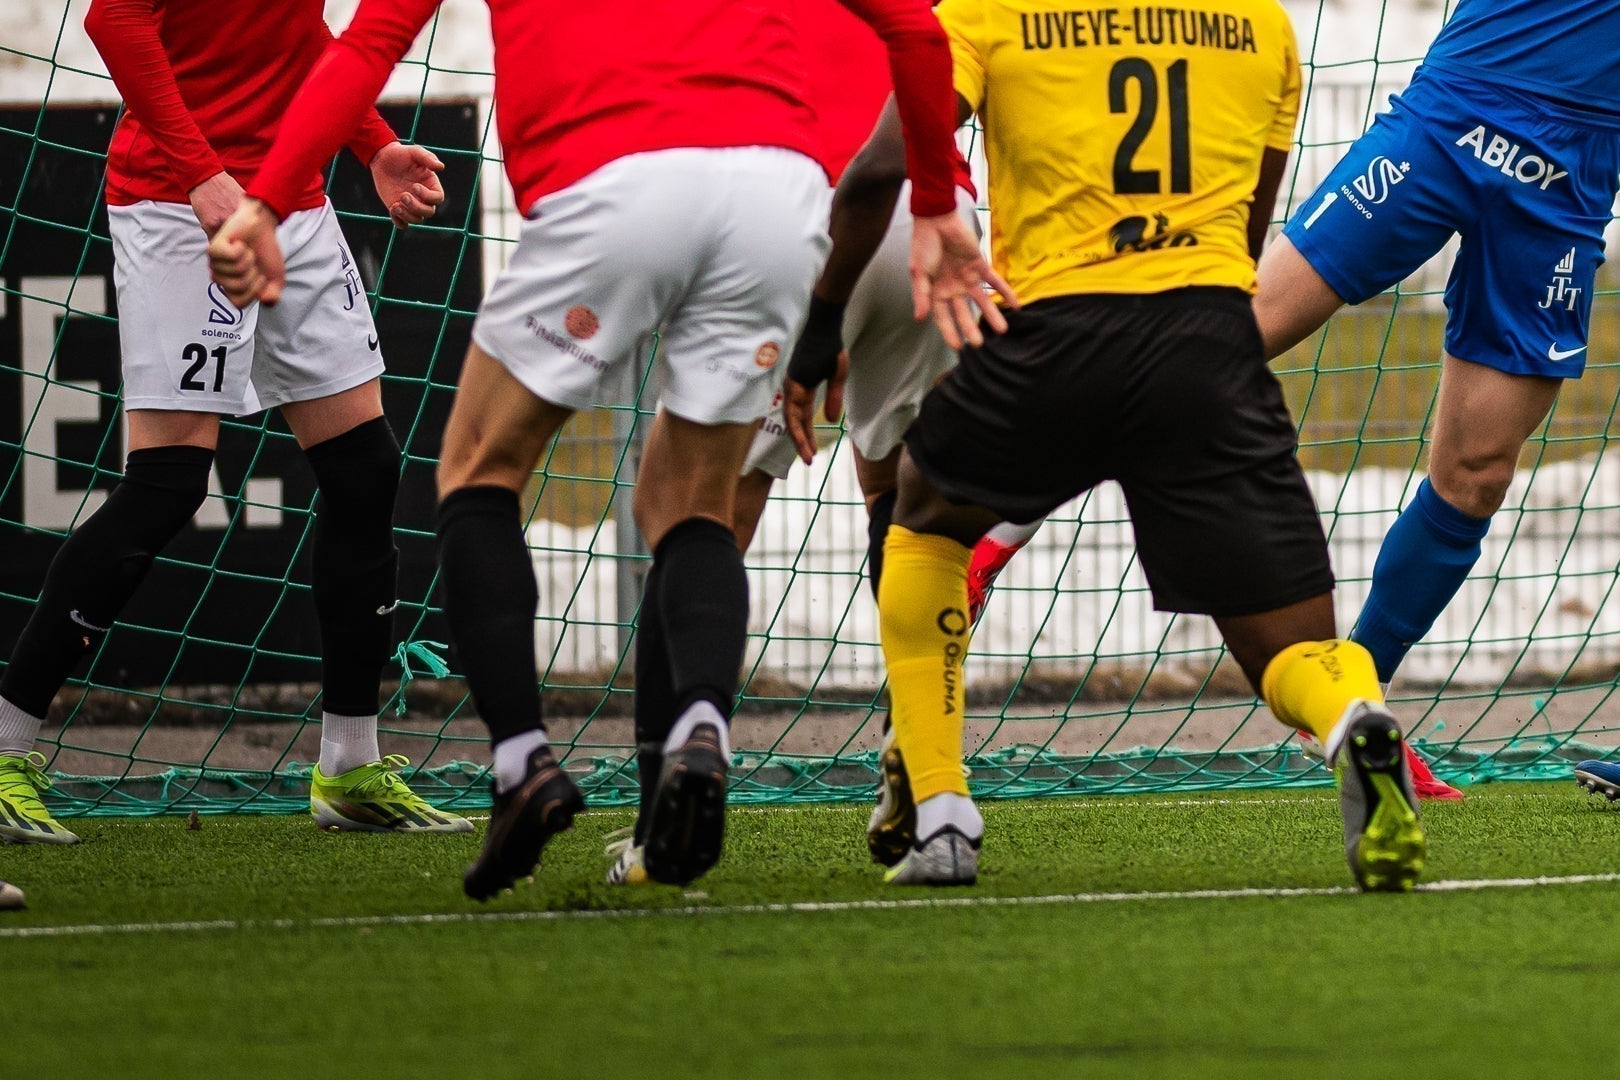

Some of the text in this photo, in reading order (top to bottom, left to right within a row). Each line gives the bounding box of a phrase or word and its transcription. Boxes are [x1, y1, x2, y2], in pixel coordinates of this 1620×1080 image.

[1021, 6, 1257, 53] LUYEYE-LUTUMBA
[1108, 57, 1192, 195] 21
[1455, 125, 1568, 191] ABLOY
[1303, 191, 1338, 230] 1
[1340, 184, 1373, 220] solenovo
[180, 342, 228, 393] 21
